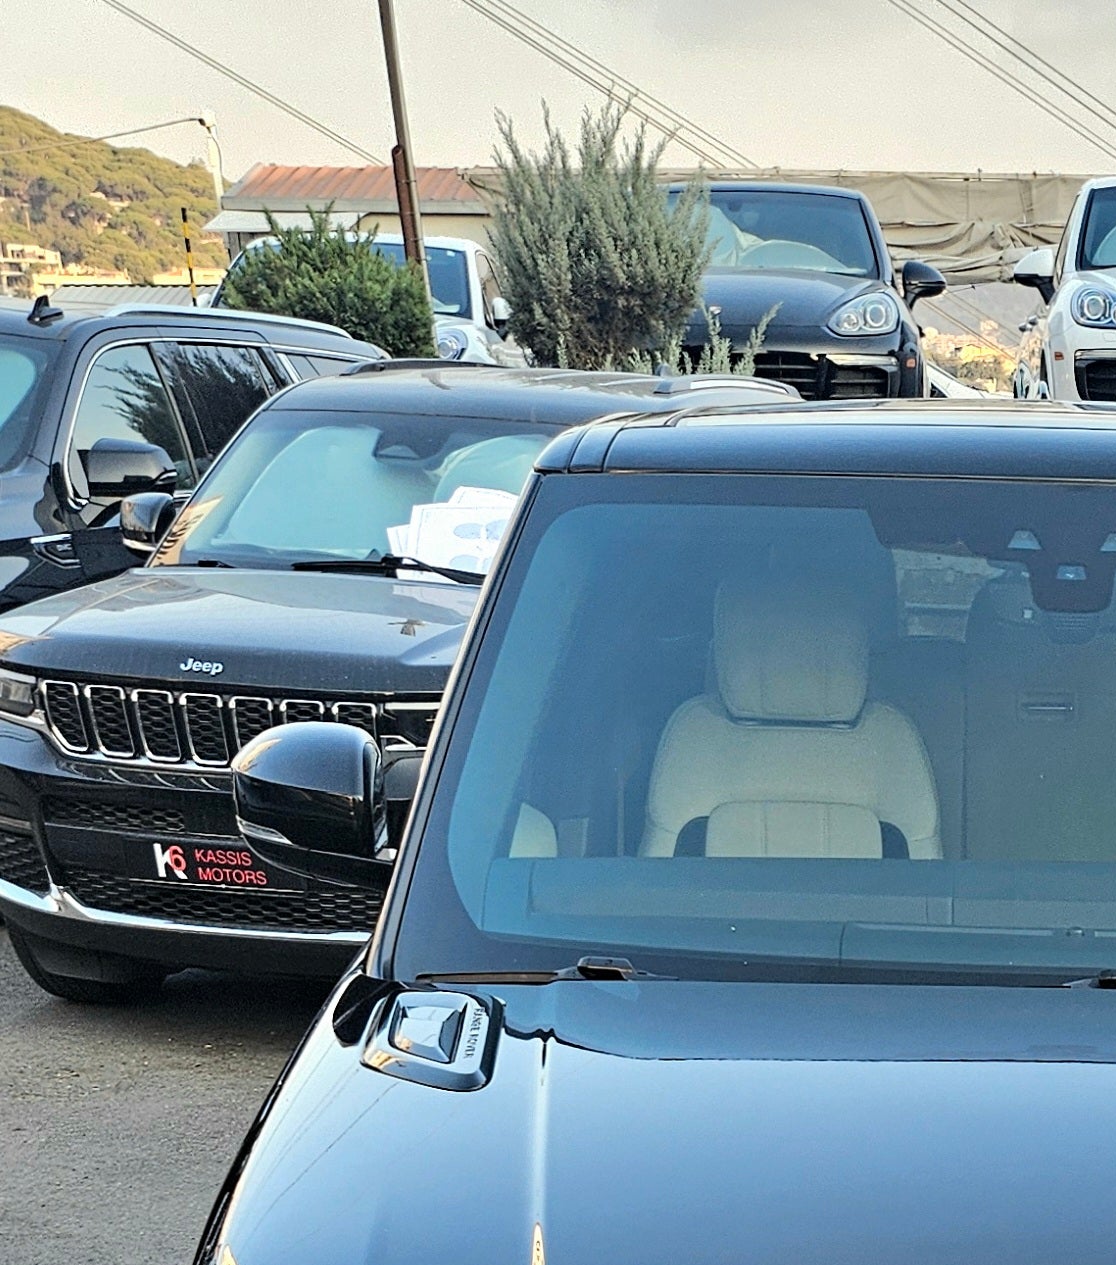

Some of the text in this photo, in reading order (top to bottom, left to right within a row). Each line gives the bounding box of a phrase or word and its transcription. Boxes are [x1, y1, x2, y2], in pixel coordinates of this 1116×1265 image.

[180, 657, 224, 676] Jeep
[153, 843, 188, 880] K6
[194, 848, 252, 867] KASSIS
[198, 866, 267, 886] MOTORS
